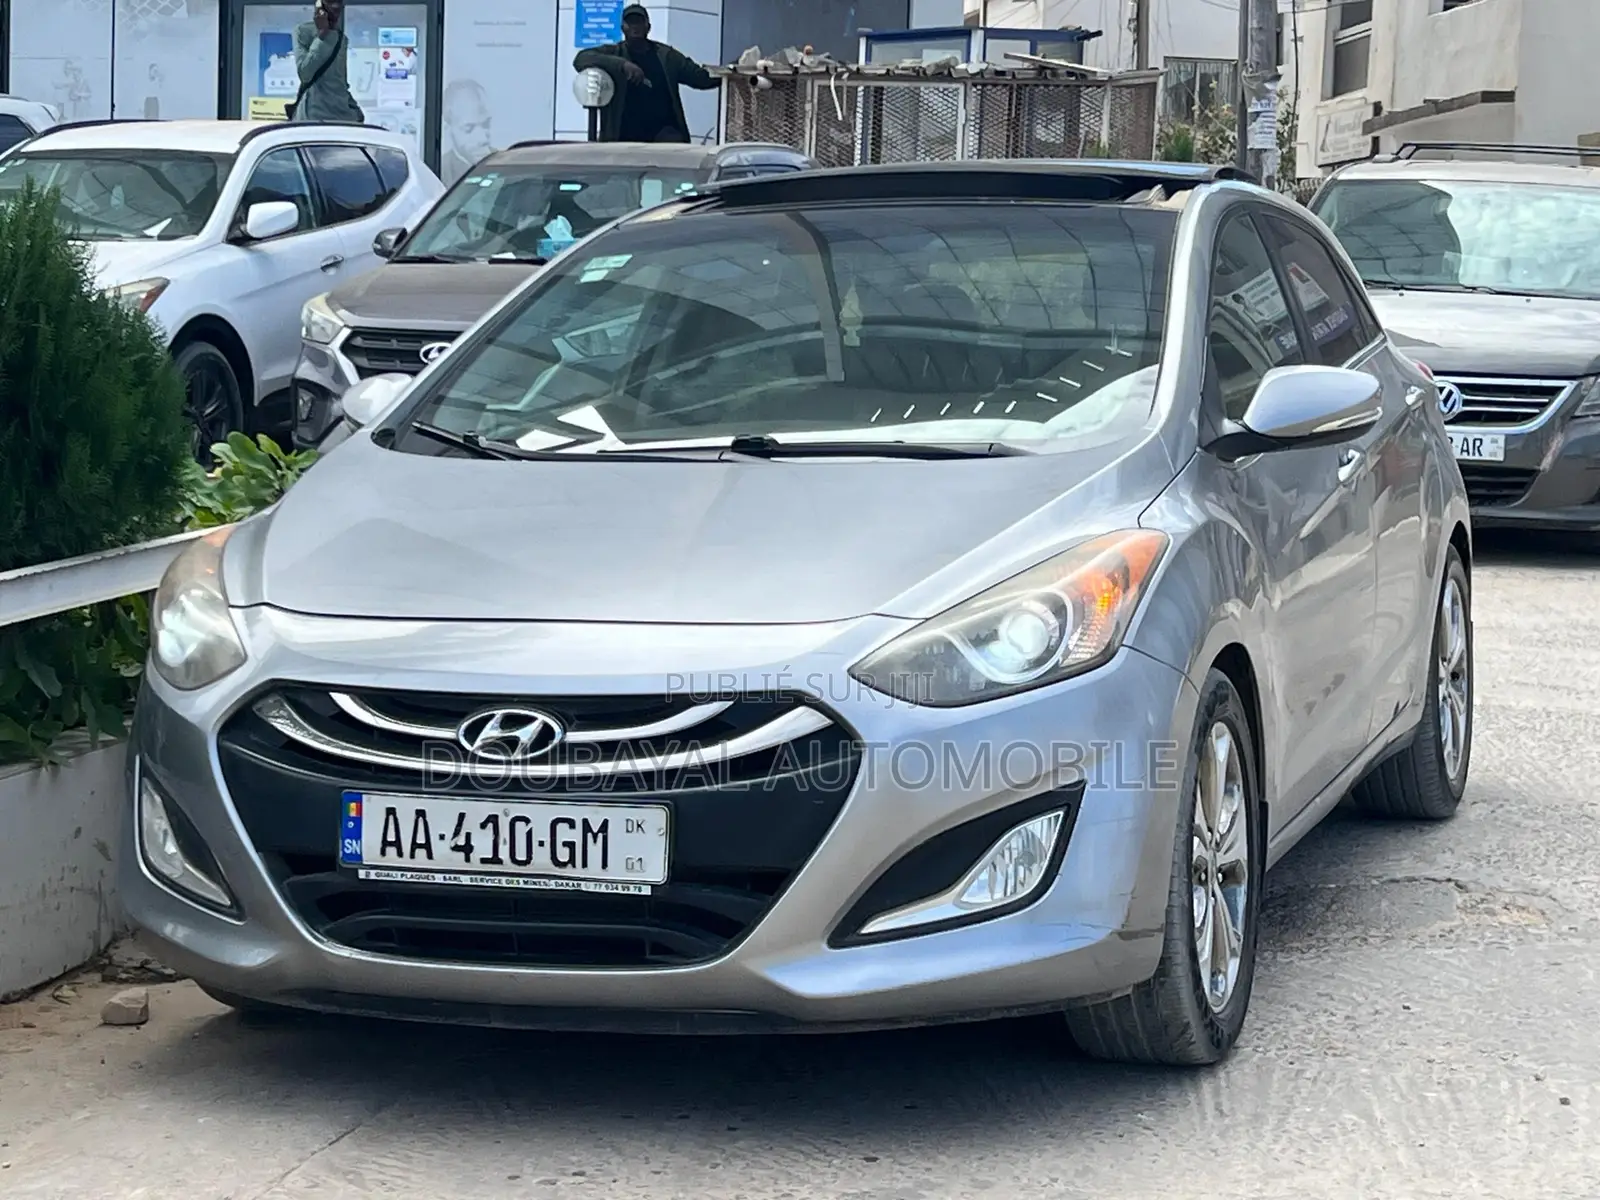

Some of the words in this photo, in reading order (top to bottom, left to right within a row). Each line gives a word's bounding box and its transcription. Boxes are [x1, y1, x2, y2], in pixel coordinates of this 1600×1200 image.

[625, 817, 646, 834] DK
[343, 838, 361, 855] SN
[469, 876, 503, 885] SERVICE
[555, 881, 582, 889] DAKAR
